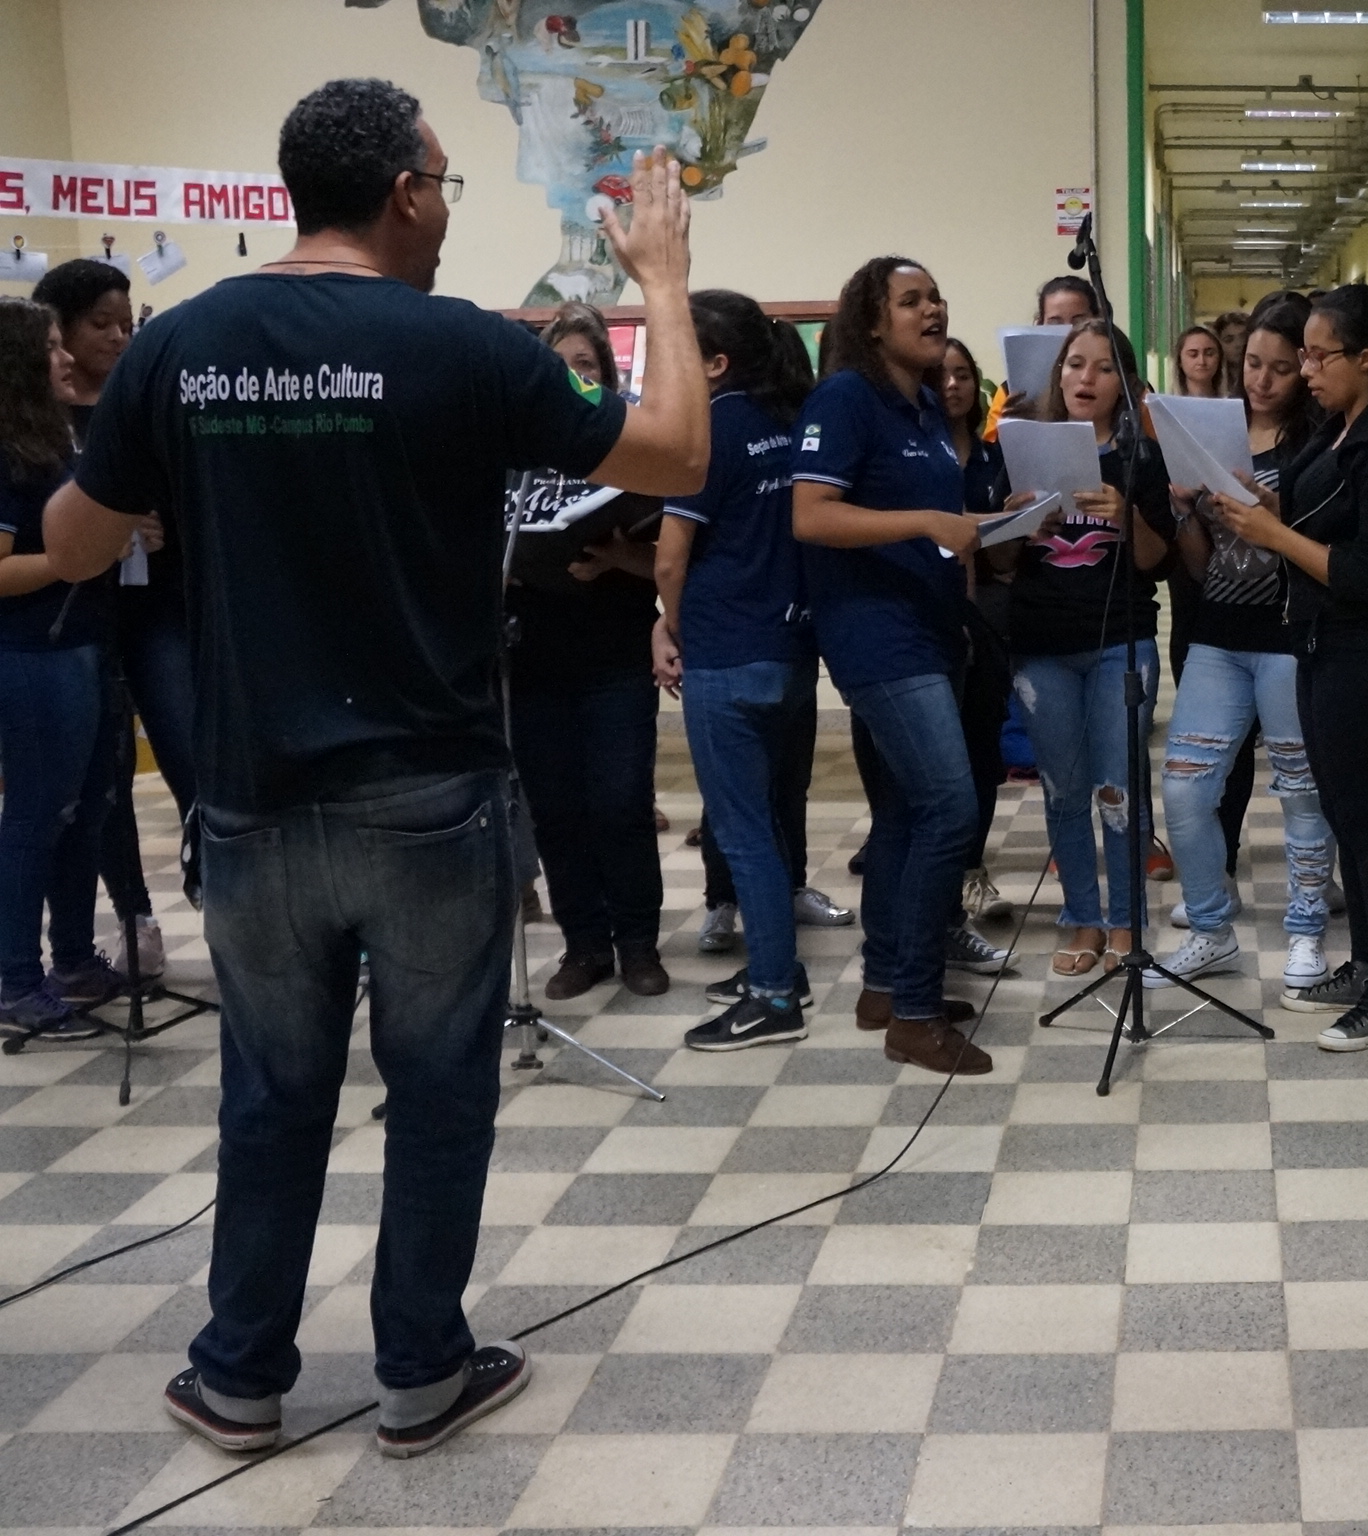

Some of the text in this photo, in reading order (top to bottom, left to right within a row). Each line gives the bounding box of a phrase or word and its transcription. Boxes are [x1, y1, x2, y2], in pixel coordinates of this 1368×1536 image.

[52, 174, 158, 217] MEUS
[183, 182, 296, 221] AMIGO
[180, 363, 384, 410] Seção de Arte e Cultura
[198, 414, 243, 435] Sudeste
[246, 414, 267, 435] MG
[315, 412, 333, 433] Rio
[334, 413, 375, 434] Pomba
